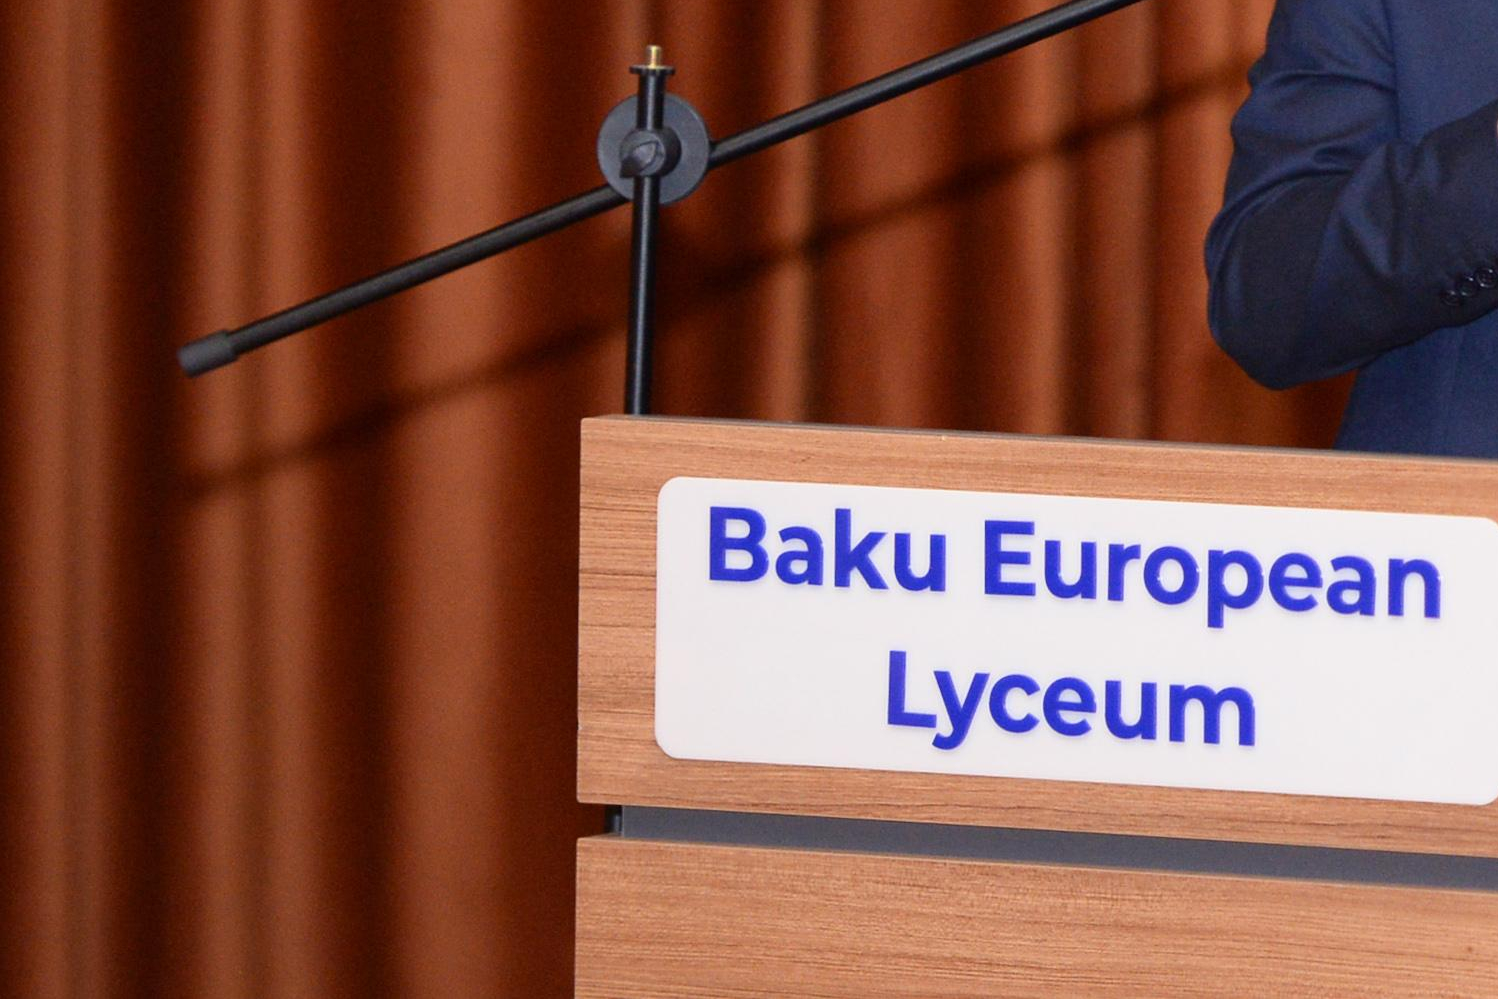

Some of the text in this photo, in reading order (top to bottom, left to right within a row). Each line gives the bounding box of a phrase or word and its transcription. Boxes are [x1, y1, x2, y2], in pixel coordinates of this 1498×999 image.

[709, 505, 1441, 629] Baku European
[887, 649, 1256, 751] Lyceum
